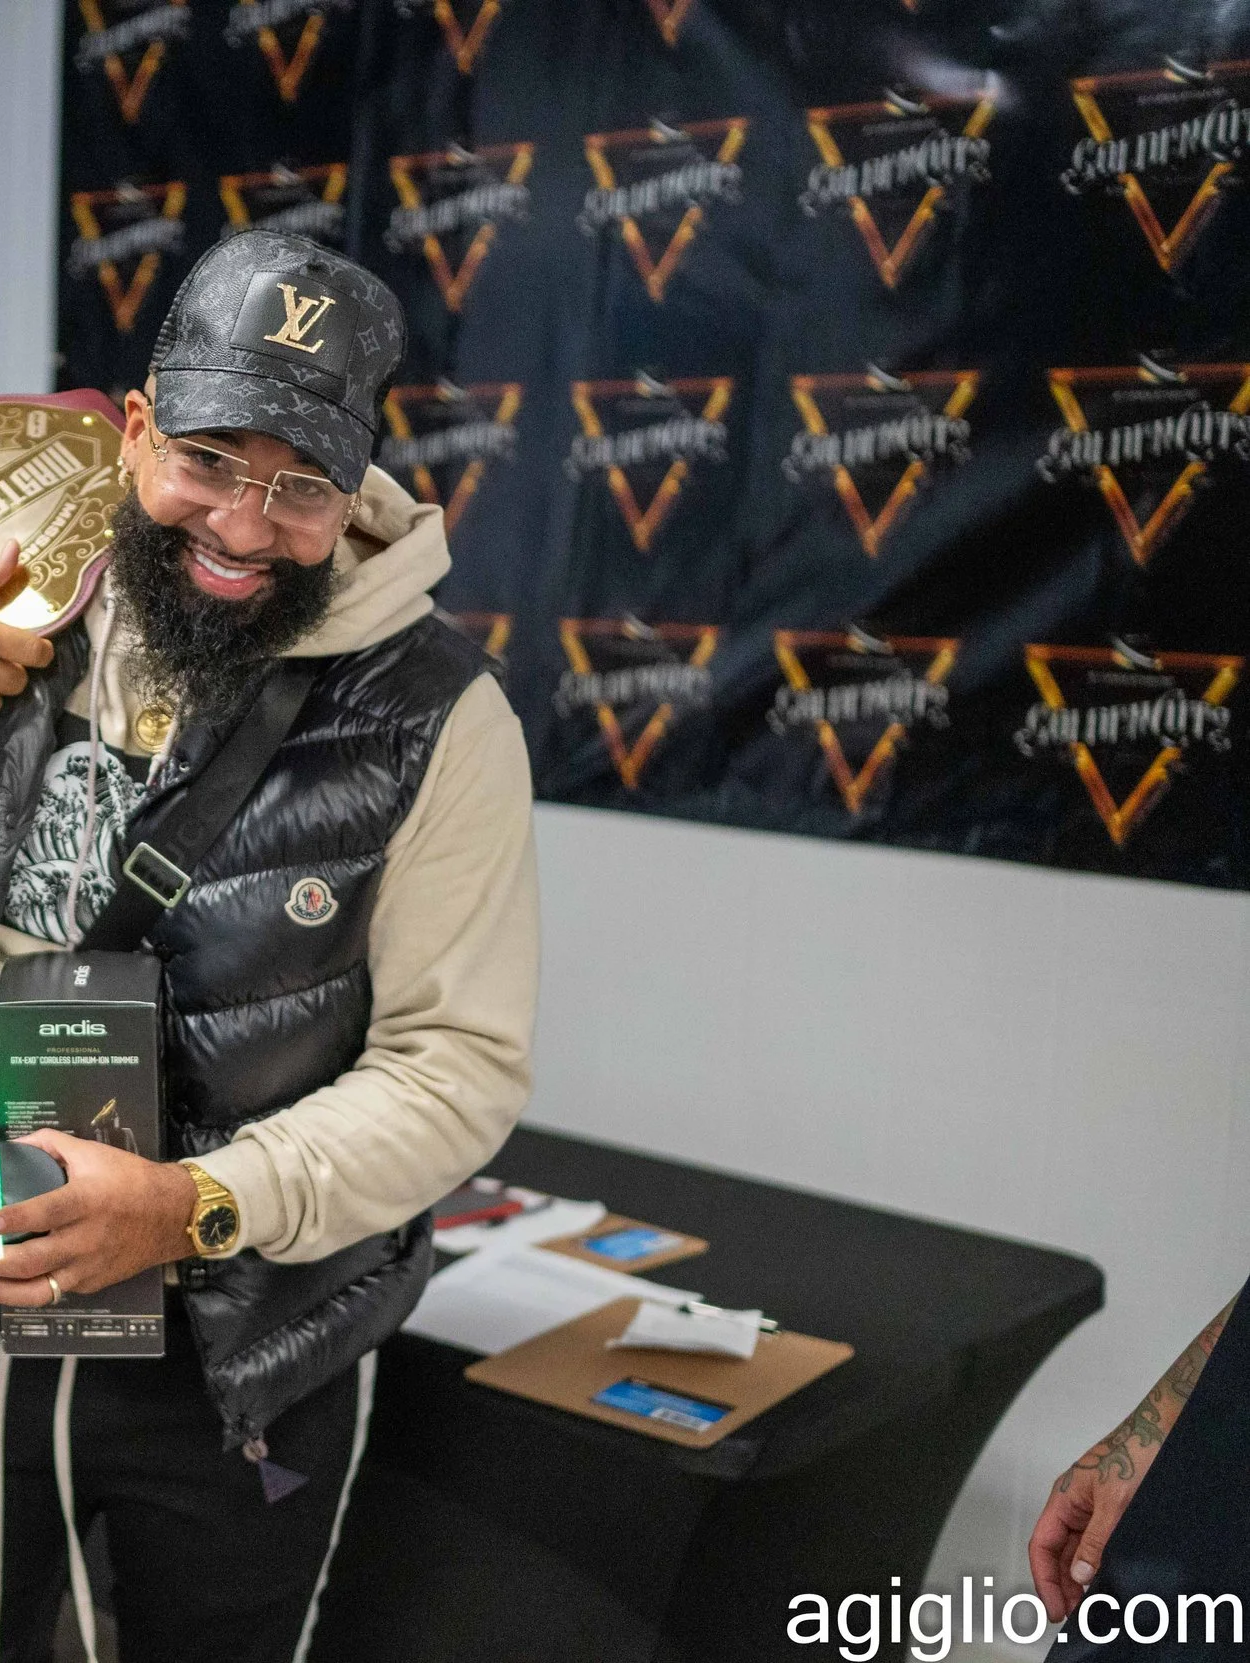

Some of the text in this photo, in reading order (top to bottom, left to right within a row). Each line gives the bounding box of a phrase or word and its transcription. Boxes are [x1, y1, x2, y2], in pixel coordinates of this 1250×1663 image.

[18, 502, 77, 564] MASSAC
[39, 1019, 107, 1036] andis
[39, 1056, 71, 1065] CORDLESS
[110, 1056, 139, 1065] TRIMMER
